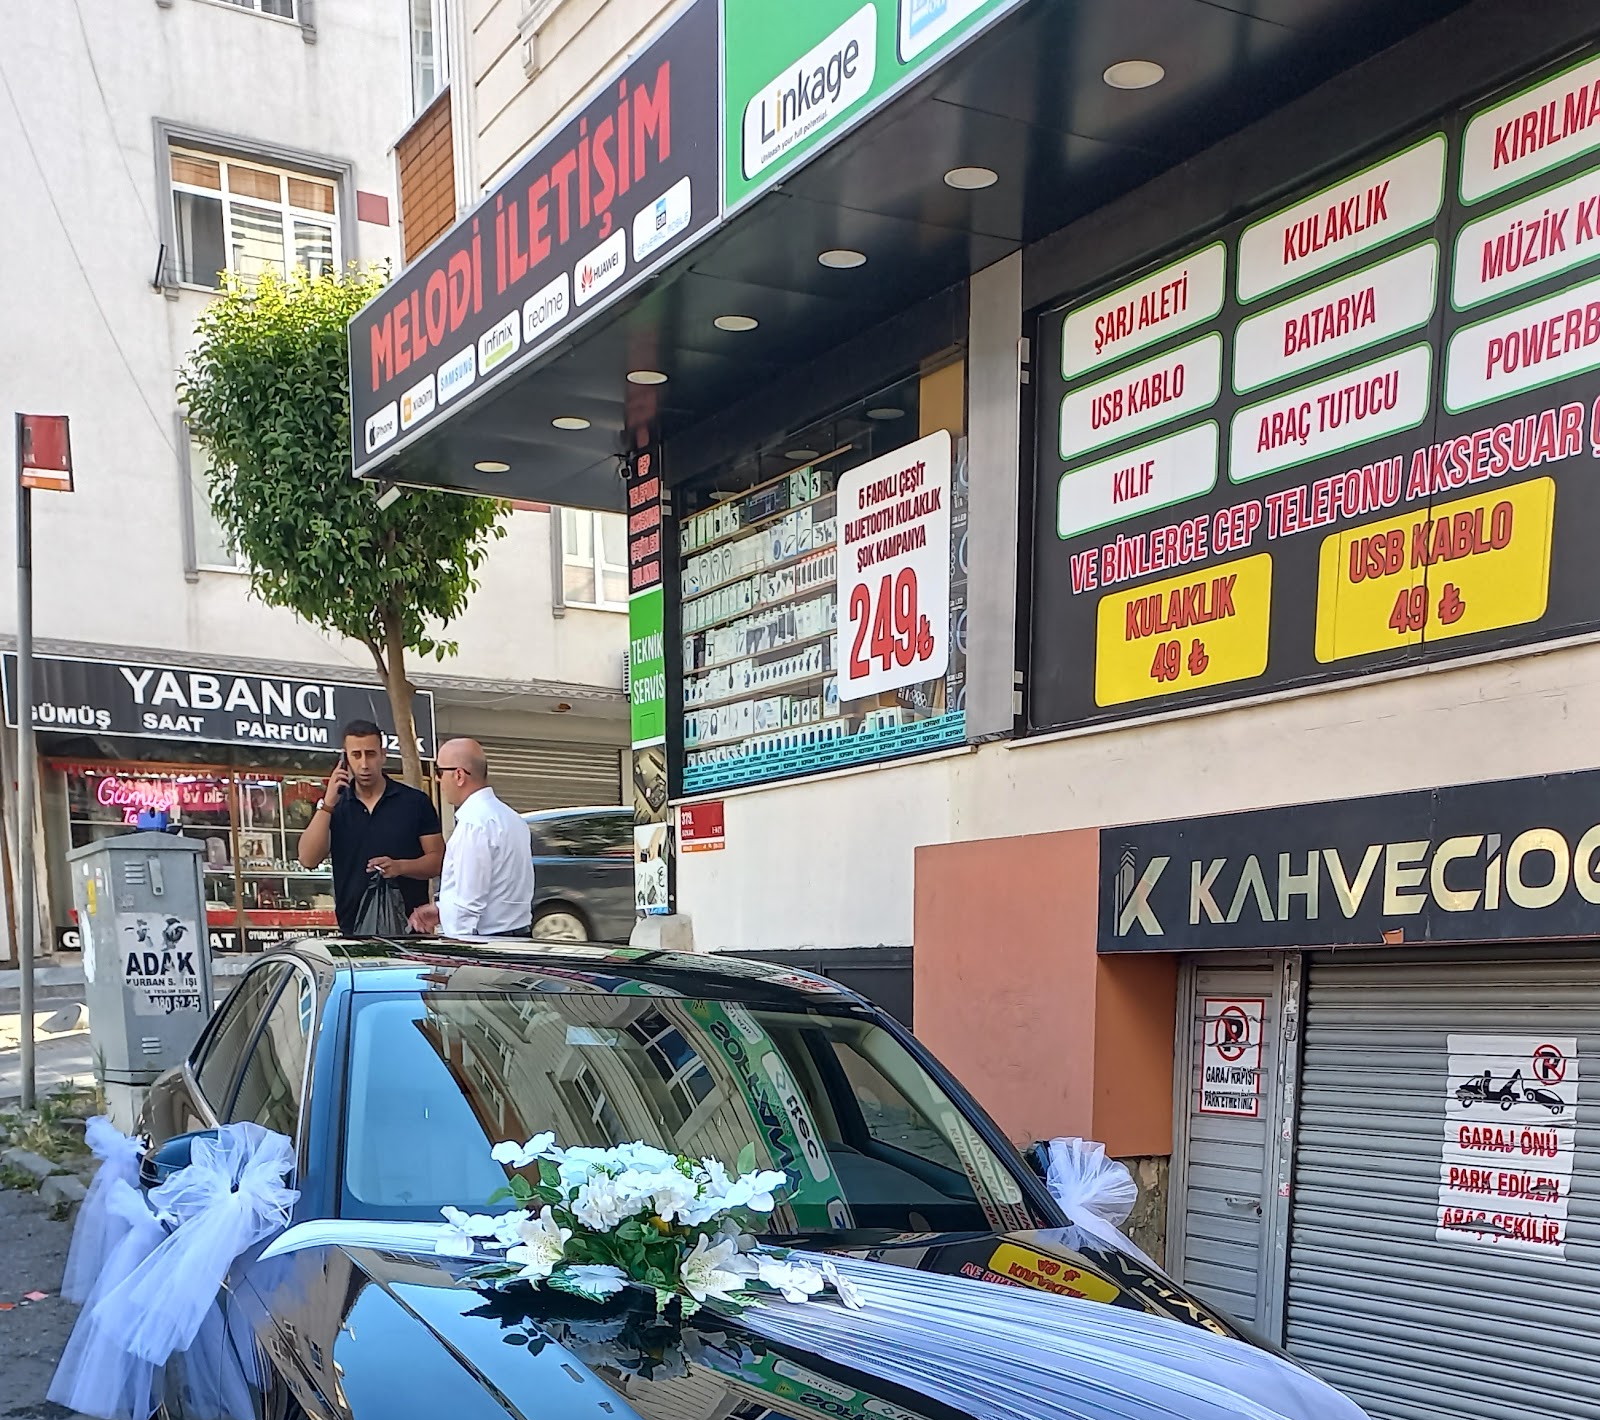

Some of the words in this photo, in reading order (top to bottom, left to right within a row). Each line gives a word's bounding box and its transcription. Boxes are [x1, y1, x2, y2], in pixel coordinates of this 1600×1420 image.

[761, 39, 859, 144] Linkage
[370, 217, 482, 392] MELODİ
[497, 60, 671, 295] İLETİŞİM
[1283, 180, 1390, 265] KULAKLIK
[1481, 207, 1569, 283] MÜZİK
[593, 252, 619, 281] HUAWEI
[528, 292, 563, 332] realme
[1094, 296, 1134, 356] ŞARJ
[1138, 270, 1189, 327] ALETİ
[1284, 287, 1376, 357] BATARYA
[484, 322, 513, 356] Infinix
[440, 357, 473, 392] SAMSUNG
[1091, 387, 1123, 430] USB
[1128, 365, 1184, 417] KABLO
[1257, 402, 1311, 453] ARAÇ
[1317, 370, 1399, 431] TUTUCU
[866, 475, 898, 505] FARKLI
[899, 460, 926, 498] ÇEŞİT
[1069, 549, 1099, 595] VE
[1101, 511, 1209, 586] BİNLERCE
[1212, 499, 1262, 553] CEP
[1265, 454, 1404, 539] TELEFONU
[1405, 401, 1585, 502] AKSESUAR
[1112, 460, 1155, 504] KILIF
[844, 504, 898, 545] BLUETOOTH
[899, 486, 942, 525] KULAKLIK
[857, 547, 876, 574] ŞOK
[876, 524, 927, 563] KAMPANYA
[1348, 530, 1405, 583] USB
[1410, 500, 1514, 570] KABLO
[1125, 575, 1236, 641] KULAKLIK
[1388, 585, 1429, 634] 49
[632, 629, 664, 666] TEKNİK
[1150, 639, 1181, 682] 49
[119, 667, 337, 721] YABANCI
[633, 671, 665, 706] SERVİS
[143, 712, 204, 733] SAAT
[236, 718, 328, 744] PARFÜM
[126, 952, 195, 976] ADAK
[1204, 1090, 1220, 1107] PARK
[1206, 1066, 1230, 1084] GARAJ
[1459, 1125, 1515, 1154] GARAJ
[1520, 1126, 1558, 1158] ÖNÜ
[1449, 1167, 1493, 1195] PARK
[1496, 1170, 1560, 1203] EDİLEN
